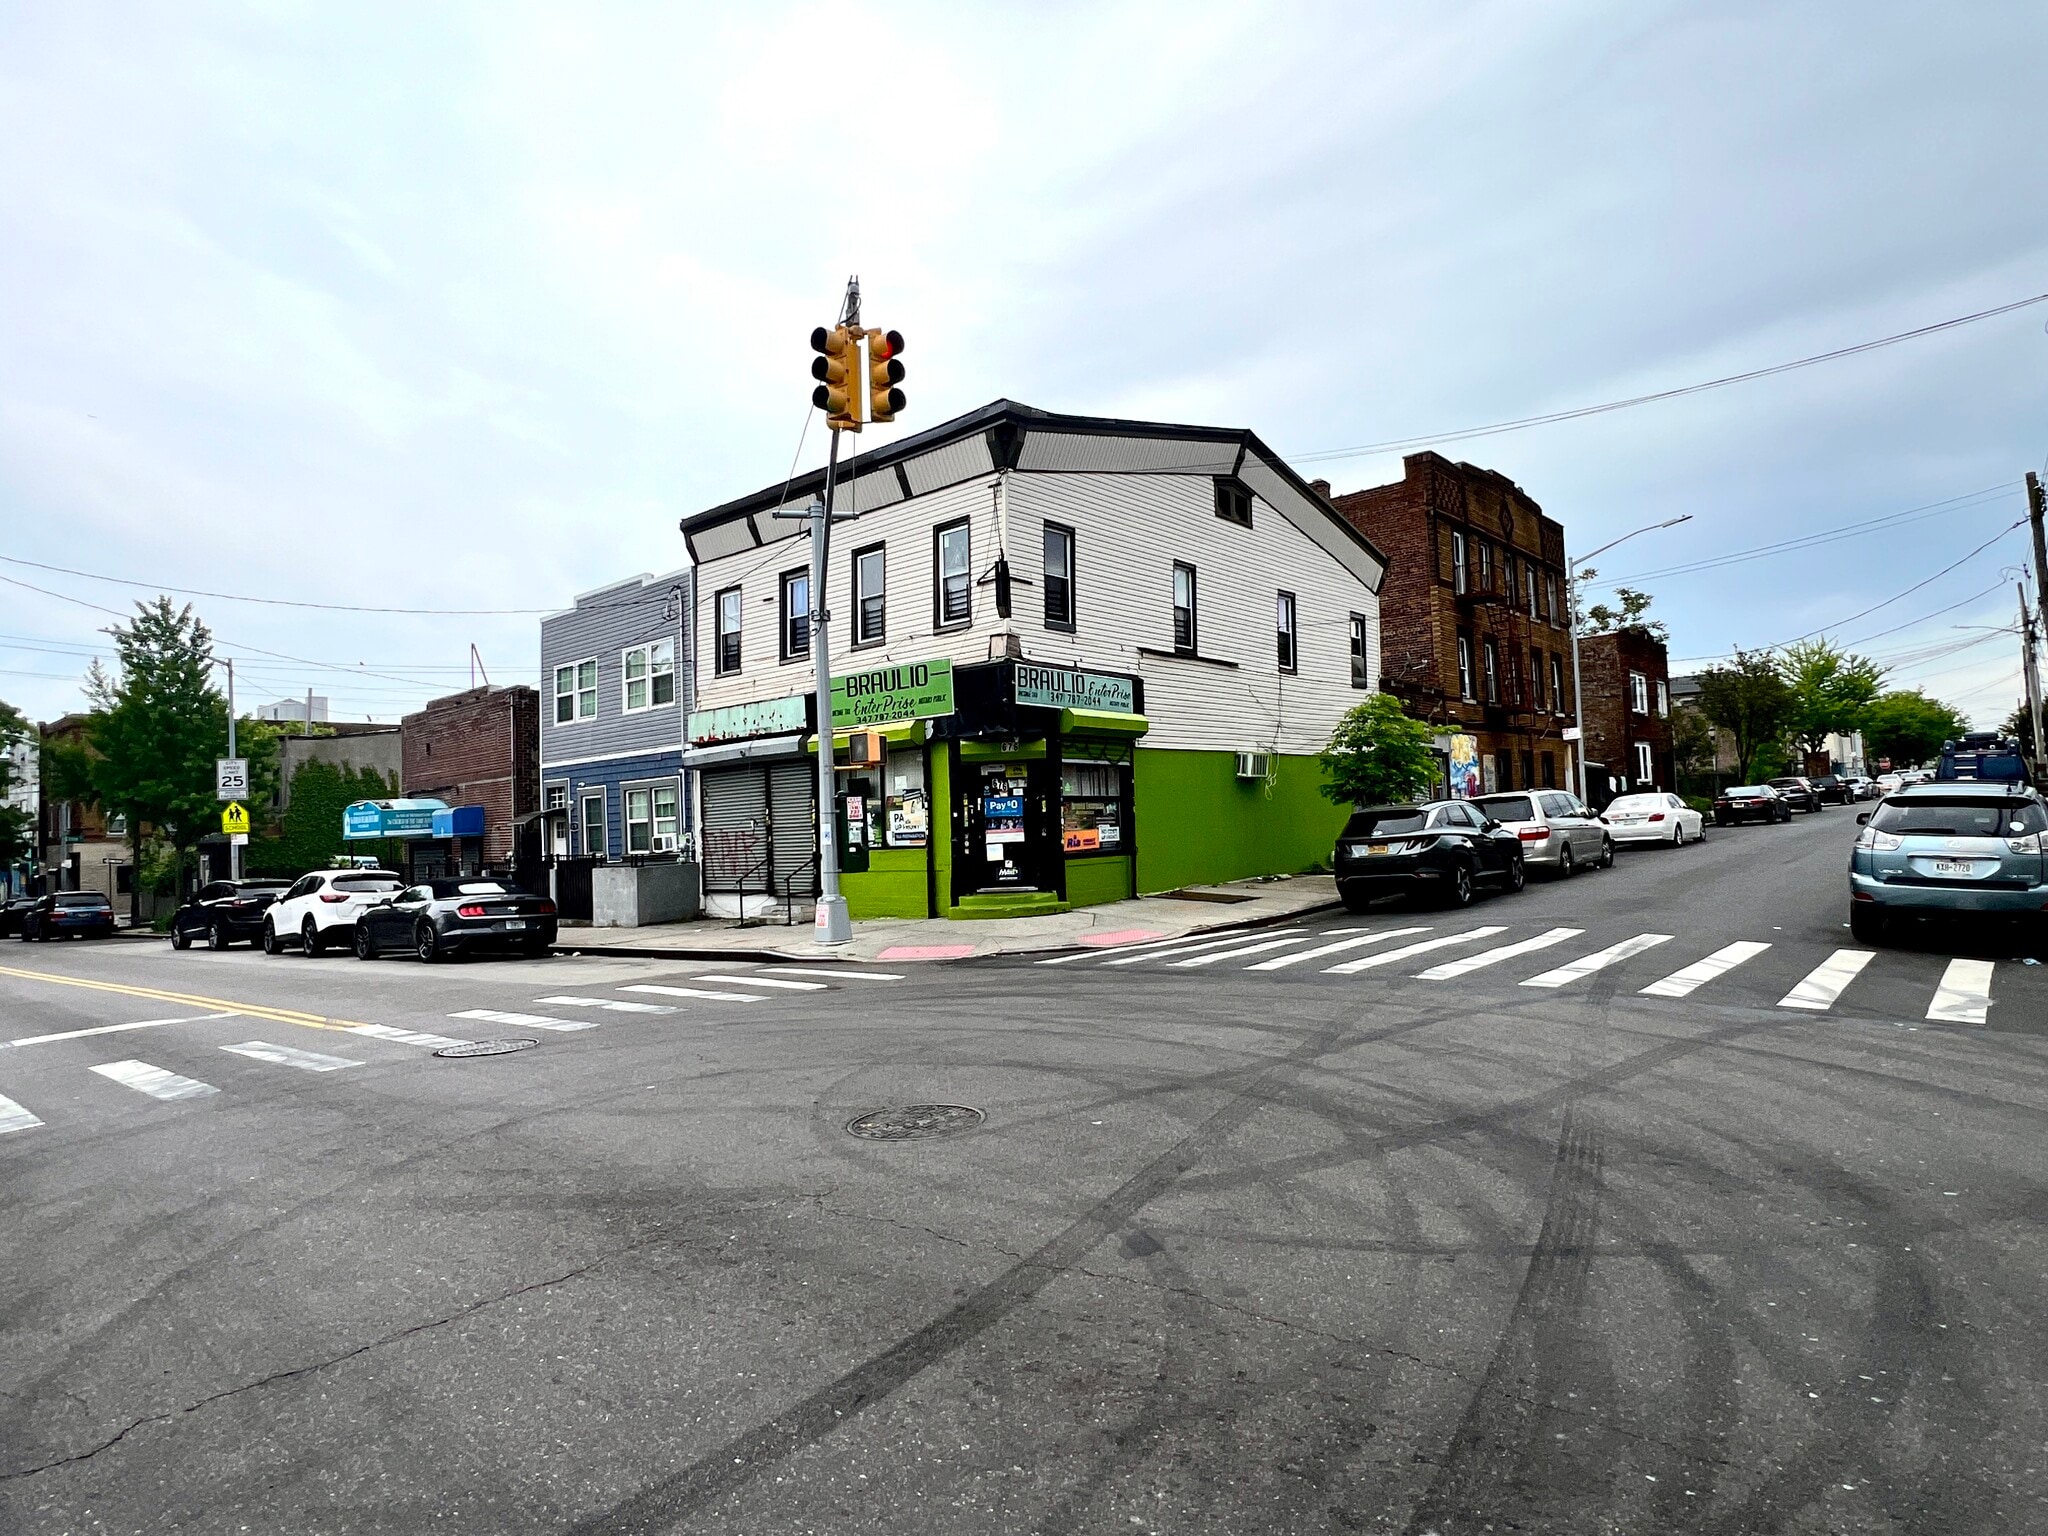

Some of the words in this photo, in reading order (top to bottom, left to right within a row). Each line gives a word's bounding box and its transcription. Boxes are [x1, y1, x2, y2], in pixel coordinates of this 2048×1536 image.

[846, 664, 928, 697] BRAULIO
[1017, 667, 1085, 694] BRAULIO
[1050, 691, 1063, 702] 347
[1067, 693, 1101, 706] 787-2044
[1002, 742, 1018, 752] 676
[222, 776, 244, 787] 25
[989, 800, 1006, 810] Pay
[1007, 799, 1018, 808] $0
